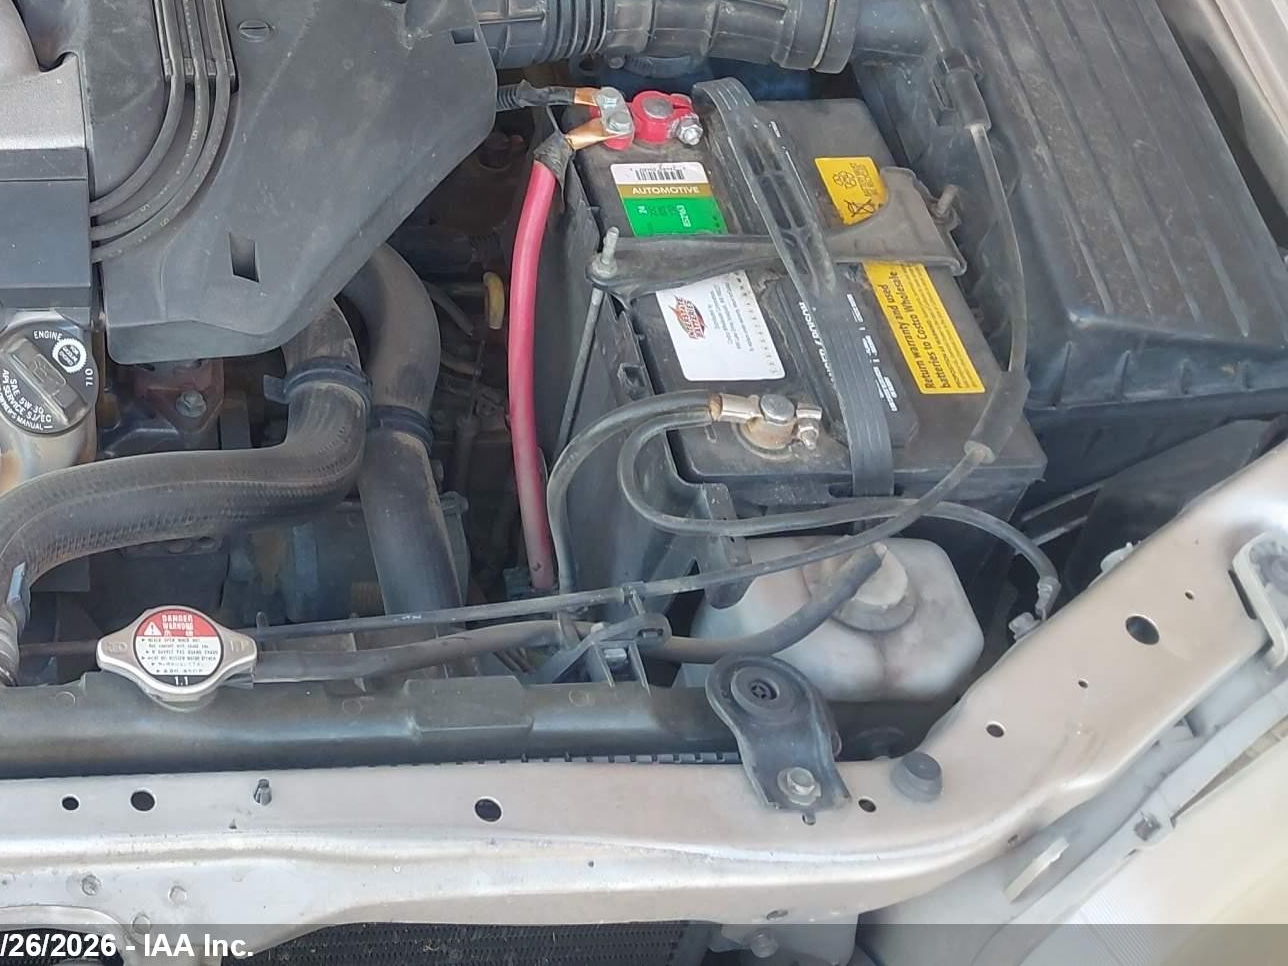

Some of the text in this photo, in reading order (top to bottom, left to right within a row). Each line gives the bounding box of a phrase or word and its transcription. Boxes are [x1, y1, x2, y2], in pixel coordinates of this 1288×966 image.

[632, 186, 701, 195] AUTOMOTIVE
[33, 330, 63, 341] ENGINE
[877, 283, 937, 390] Return warranty and used
[888, 270, 952, 390] batteries to Costco Wholesale
[2, 369, 10, 384] API
[85, 368, 93, 386] OIL
[10, 379, 20, 396] SAE
[3, 385, 25, 414] SERVICE
[16, 416, 44, 430] MANUAL
[174, 676, 189, 686] 1.1
